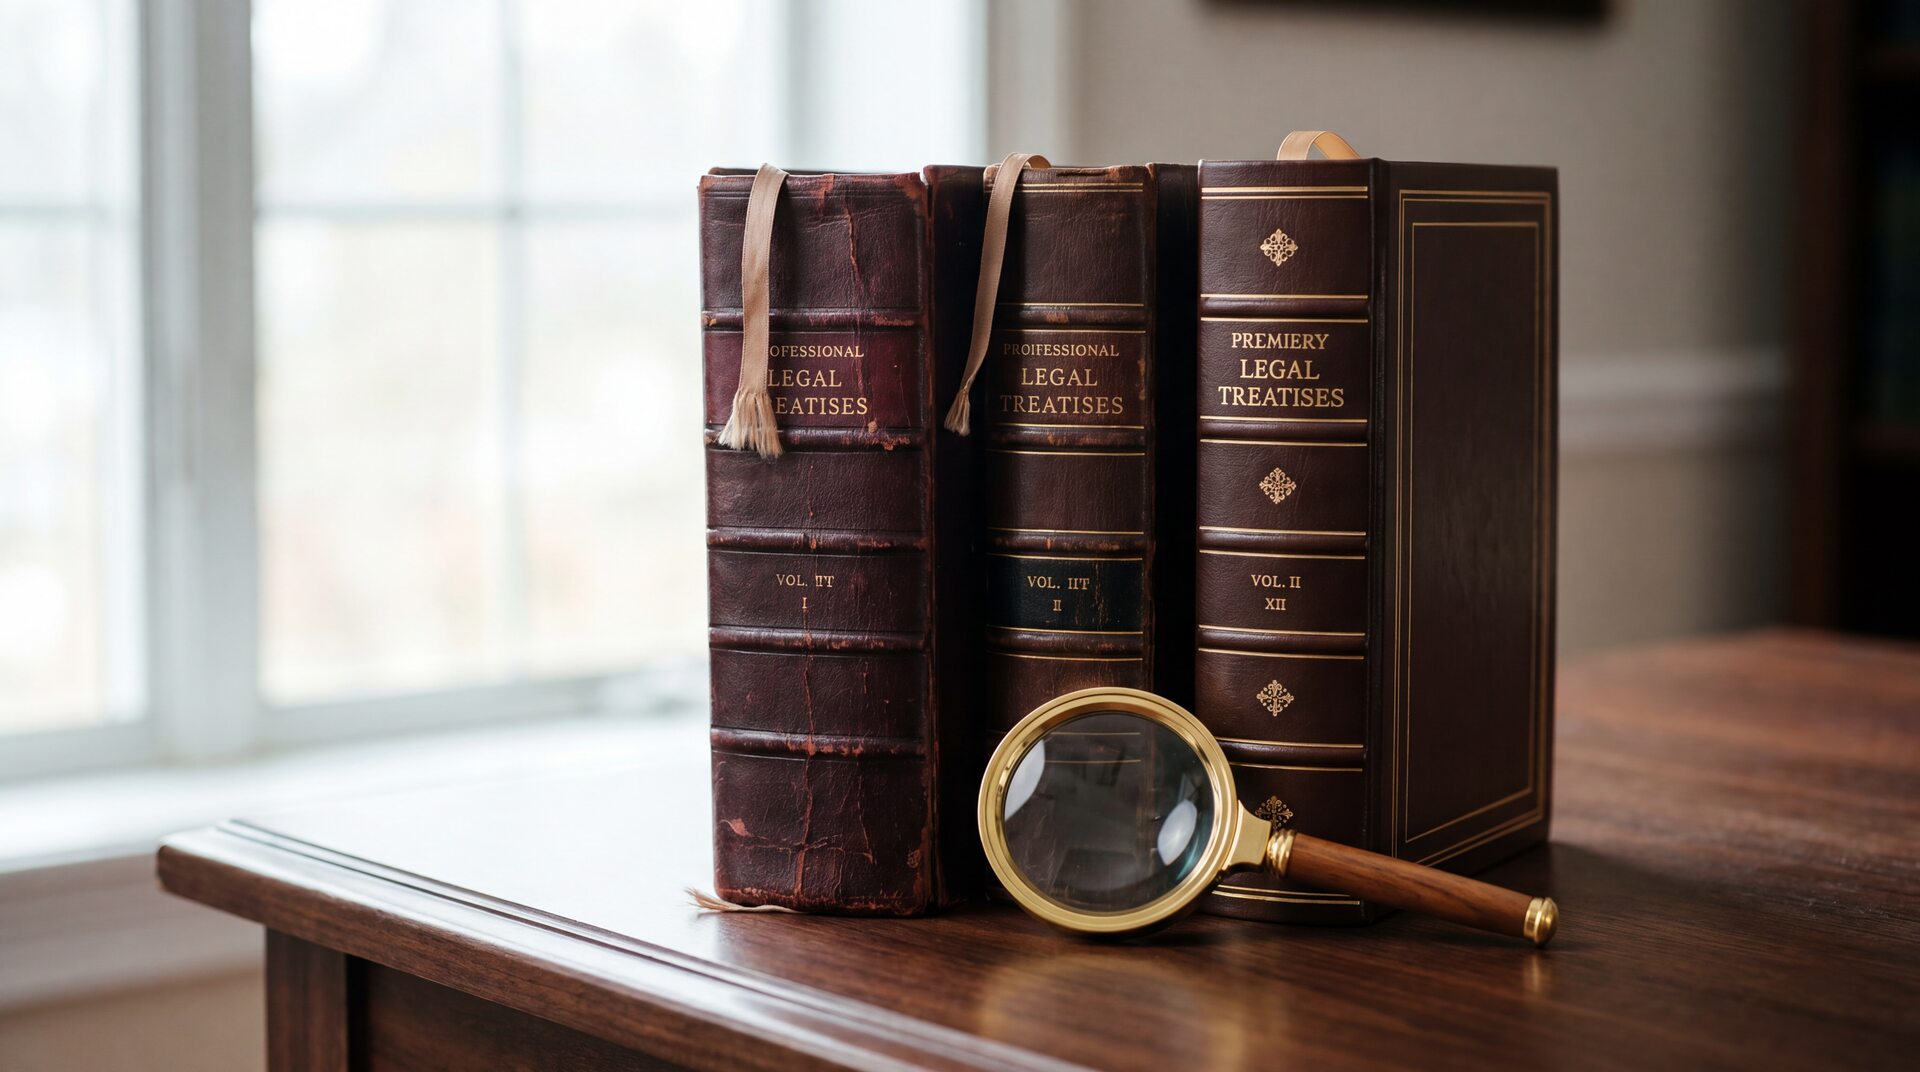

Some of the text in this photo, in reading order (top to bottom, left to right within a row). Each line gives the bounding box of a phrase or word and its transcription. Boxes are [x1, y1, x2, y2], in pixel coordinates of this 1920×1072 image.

[1231, 332, 1329, 350] PREMIERY
[769, 345, 864, 358] OFESSIONAL
[768, 369, 842, 387] LEGAL
[1021, 367, 1098, 386] LEGAL
[1240, 359, 1320, 380] LEGAL
[775, 397, 868, 415] EATISES
[1000, 395, 1124, 415] TREATISES
[1218, 386, 1344, 408] TREATISES
[776, 574, 808, 587] VOL.
[1027, 575, 1060, 589] VOL.
[1251, 574, 1301, 589] VOL. II
[1053, 599, 1062, 612] II
[1265, 597, 1287, 611] XII
